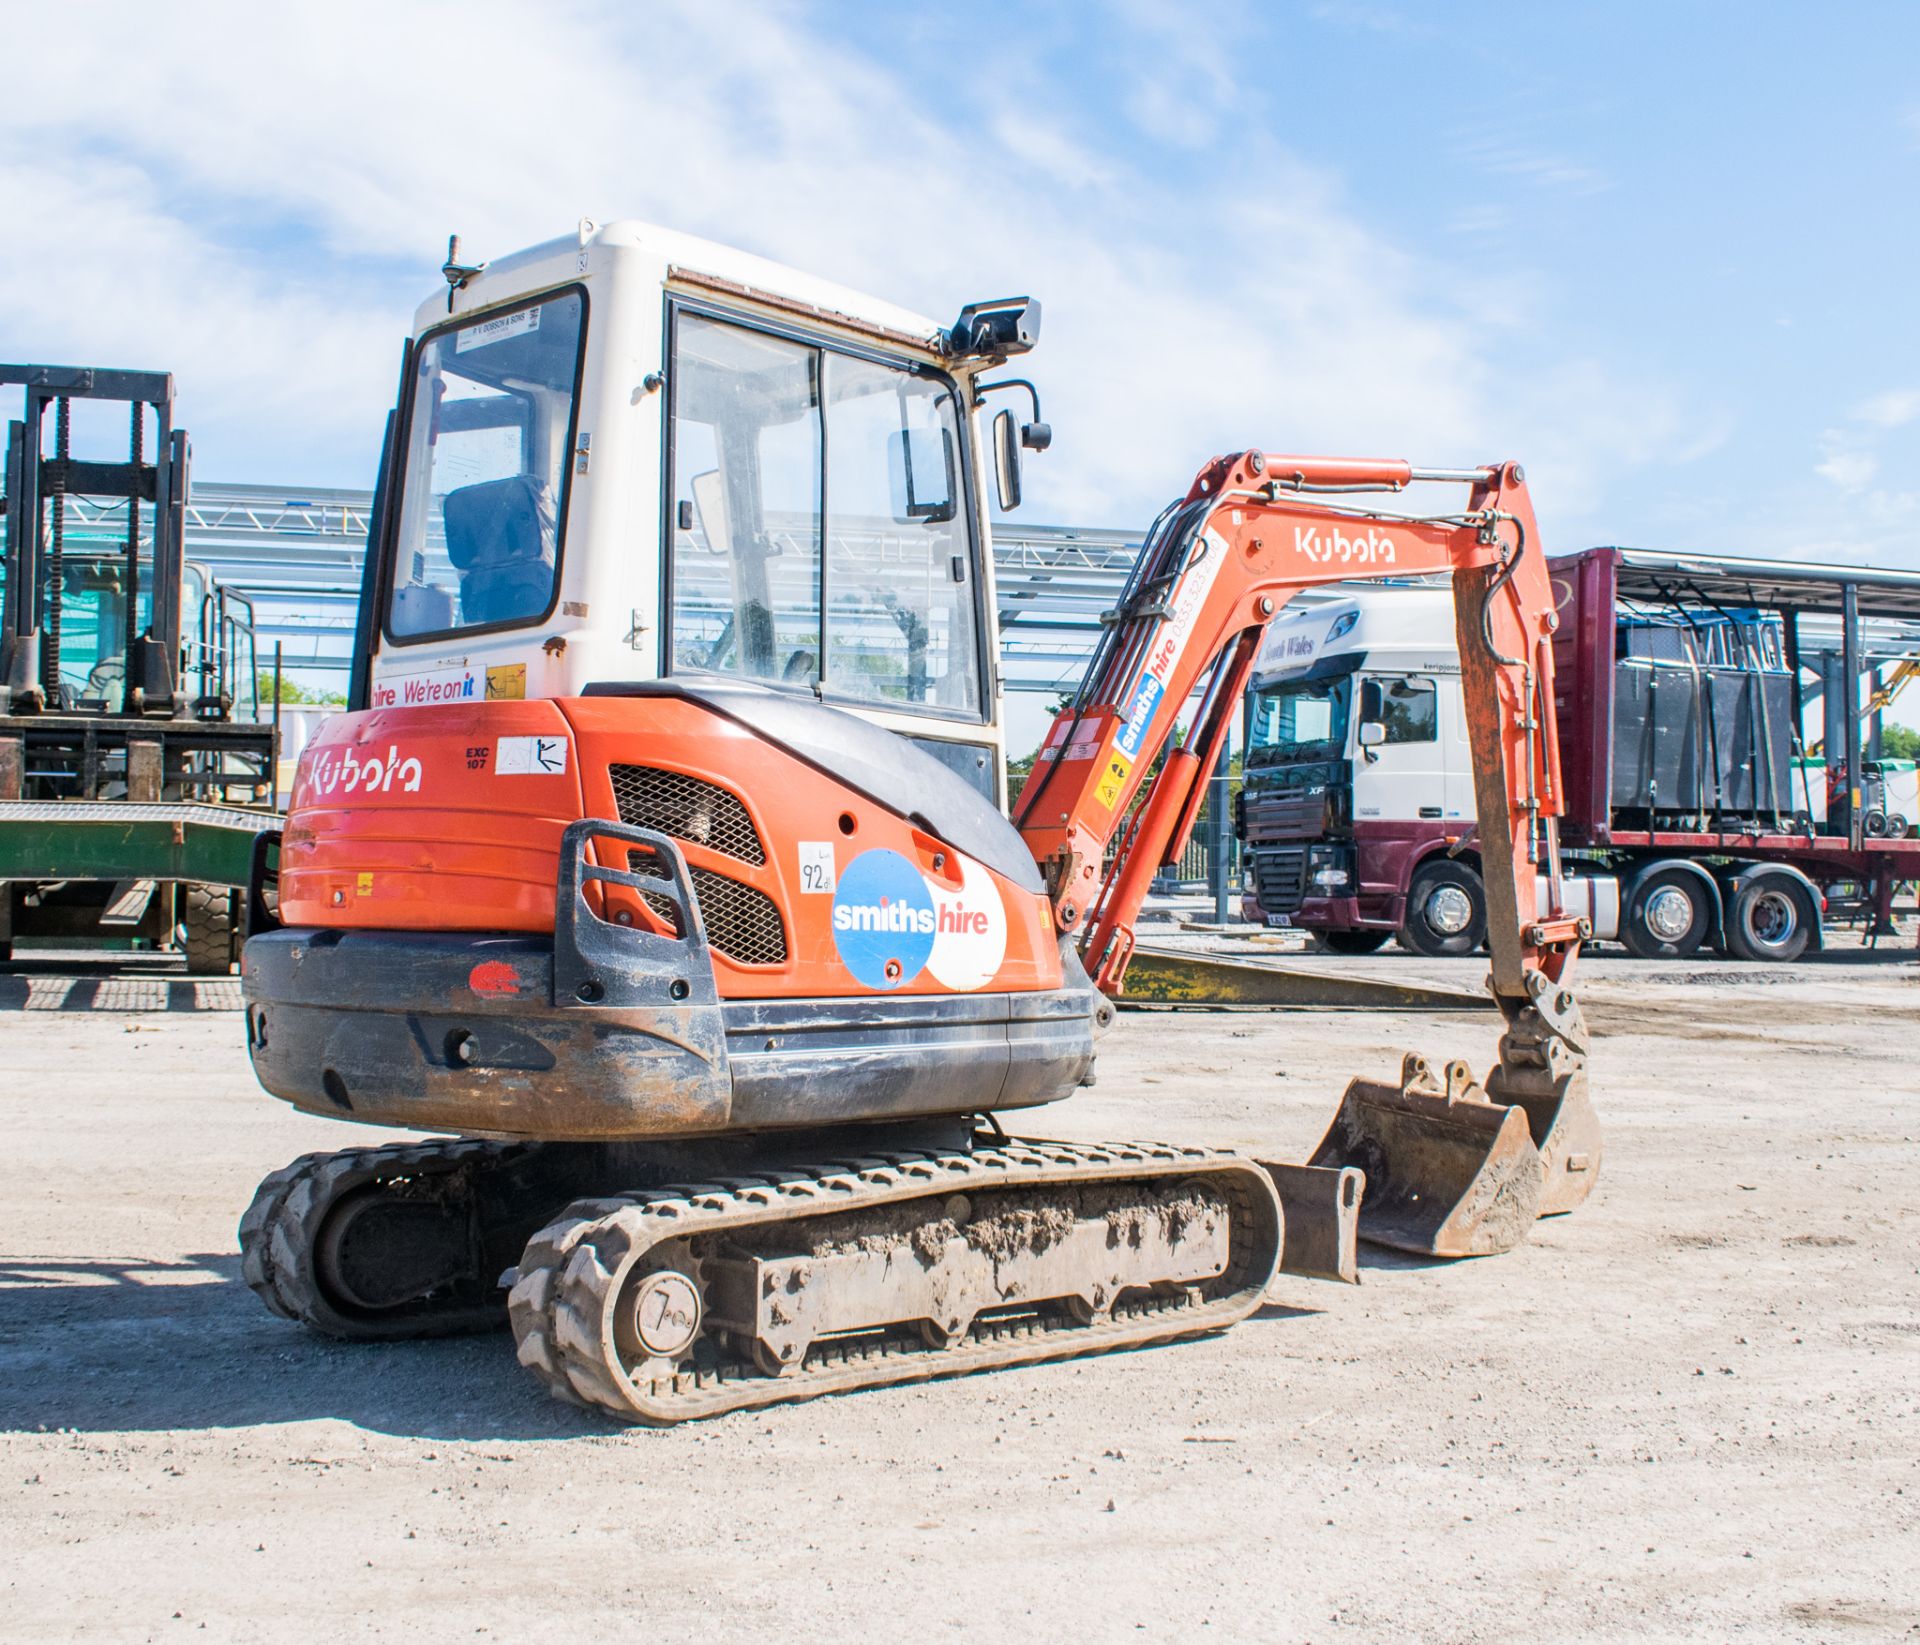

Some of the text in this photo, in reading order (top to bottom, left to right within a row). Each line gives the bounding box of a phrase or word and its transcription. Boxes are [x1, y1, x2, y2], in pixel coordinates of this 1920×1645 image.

[483, 317, 504, 333] DOBSON
[1294, 526, 1395, 562] Kubota
[1287, 635, 1314, 657] Wales
[404, 679, 441, 704] We're
[443, 681, 462, 700] on
[462, 672, 475, 697] it
[1122, 678, 1160, 751] smiths
[1151, 638, 1176, 681] hire
[466, 747, 489, 759] EXC
[467, 759, 487, 769] 107
[308, 745, 422, 795] Kubota
[1308, 786, 1325, 796] XF
[803, 864, 823, 889] 92
[834, 895, 989, 935] smiths hire
